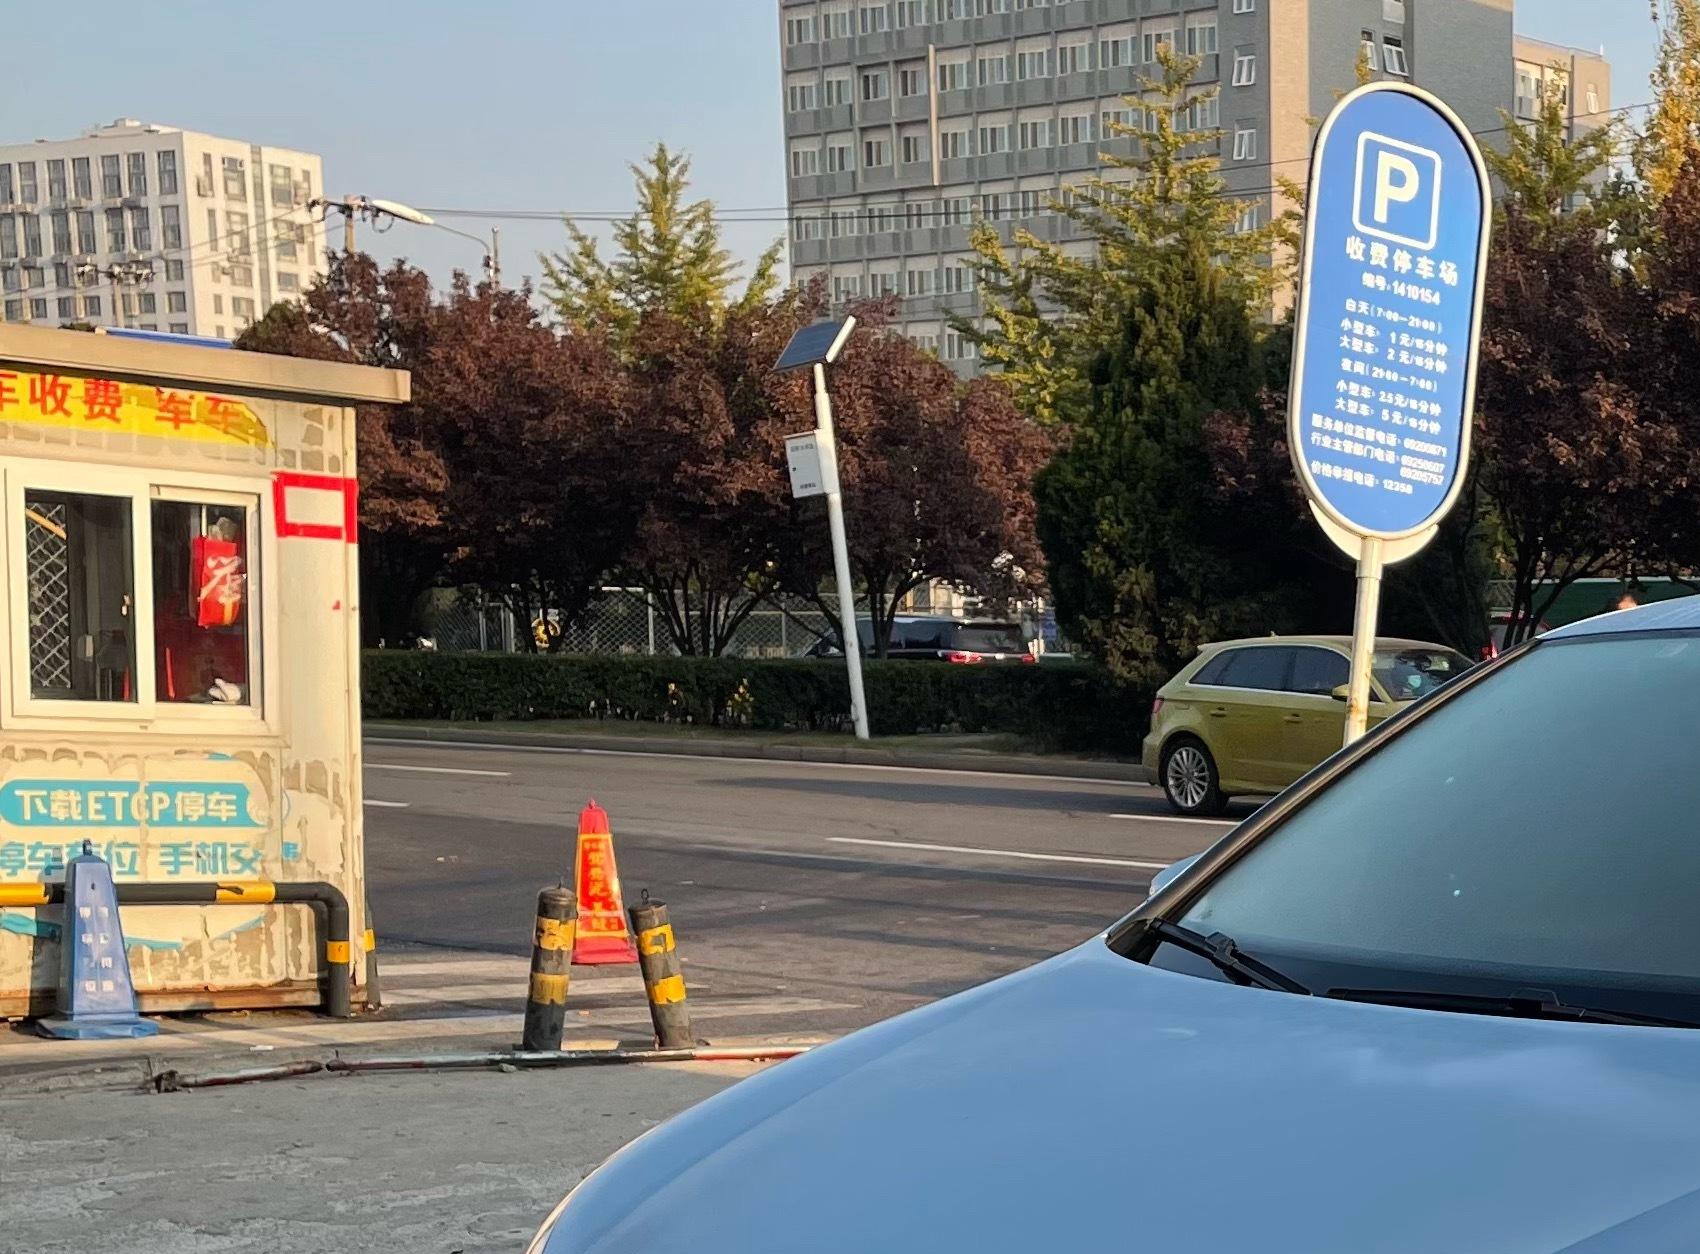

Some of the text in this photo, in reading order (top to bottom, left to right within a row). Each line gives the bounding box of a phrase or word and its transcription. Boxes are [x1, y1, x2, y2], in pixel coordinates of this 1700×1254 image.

[1374, 150, 1419, 224] P
[1346, 235, 1458, 287] 收费停车场
[0, 840, 140, 876] 停车位
